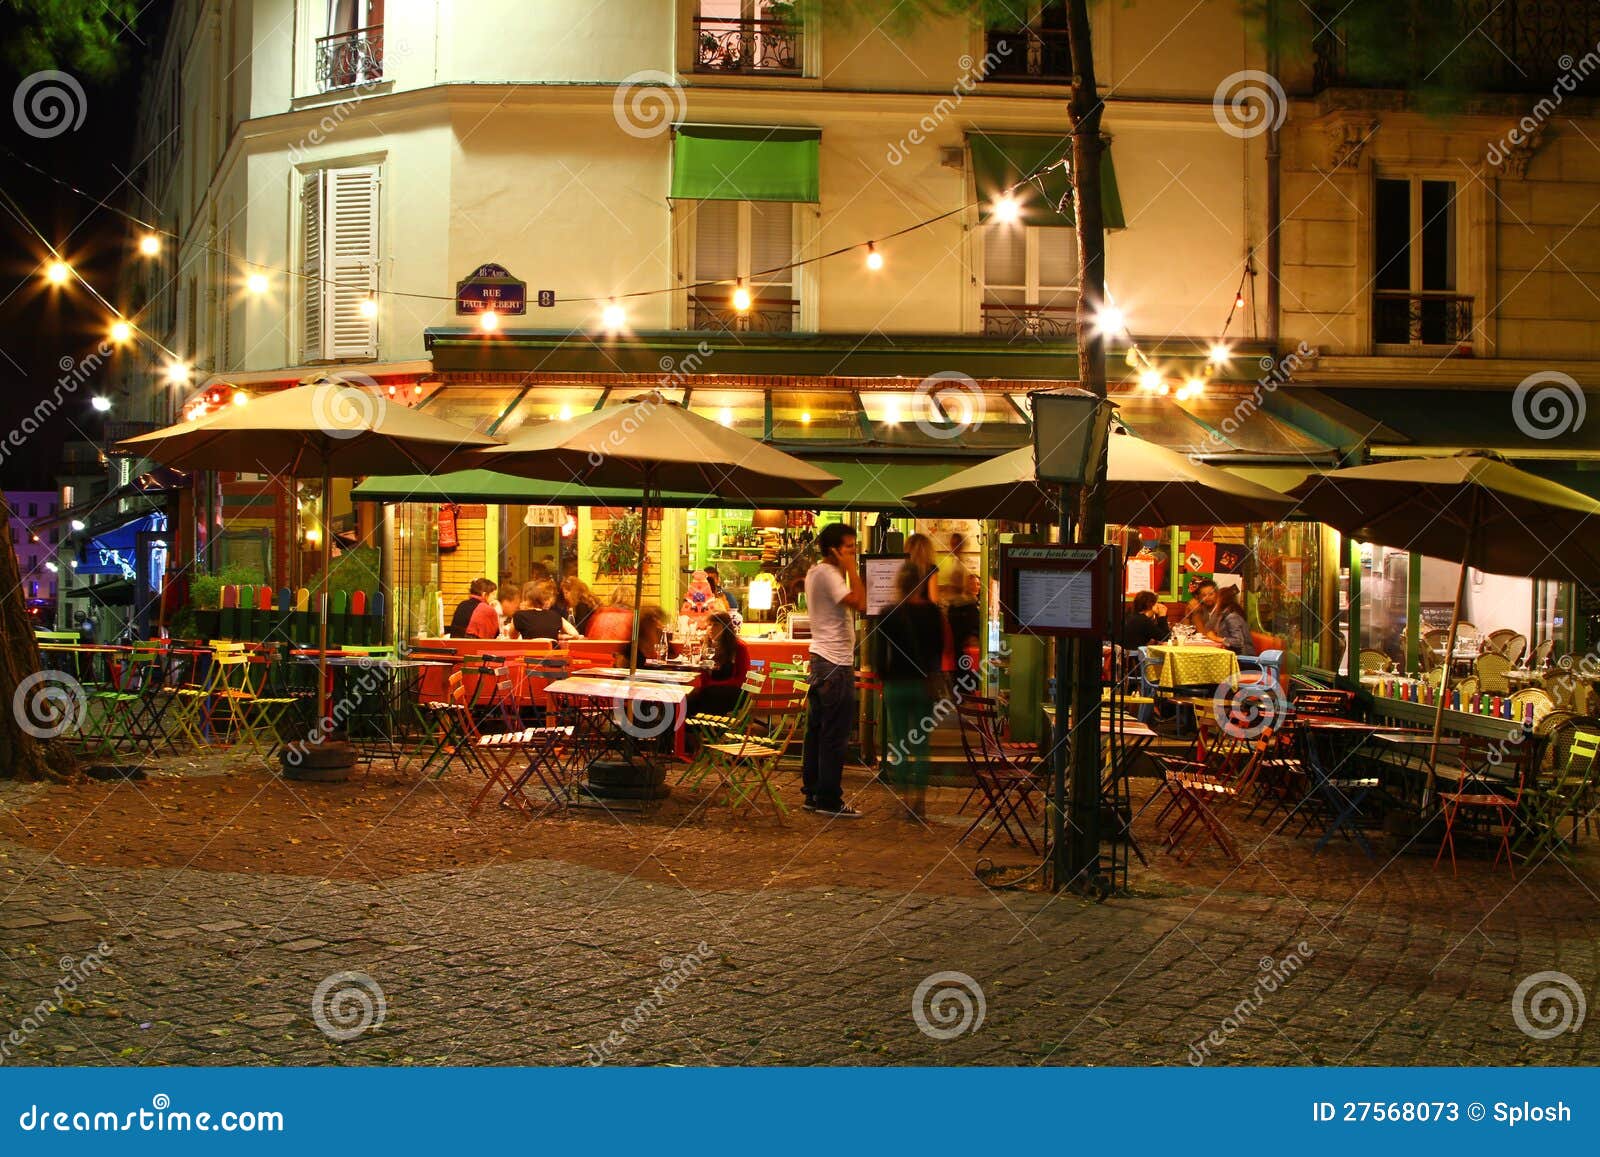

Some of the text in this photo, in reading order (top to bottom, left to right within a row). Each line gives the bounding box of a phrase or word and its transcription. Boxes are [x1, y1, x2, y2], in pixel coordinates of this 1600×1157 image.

[482, 288, 501, 297] RUE
[542, 291, 551, 306] 8
[463, 300, 520, 309] PAUL LBERT
